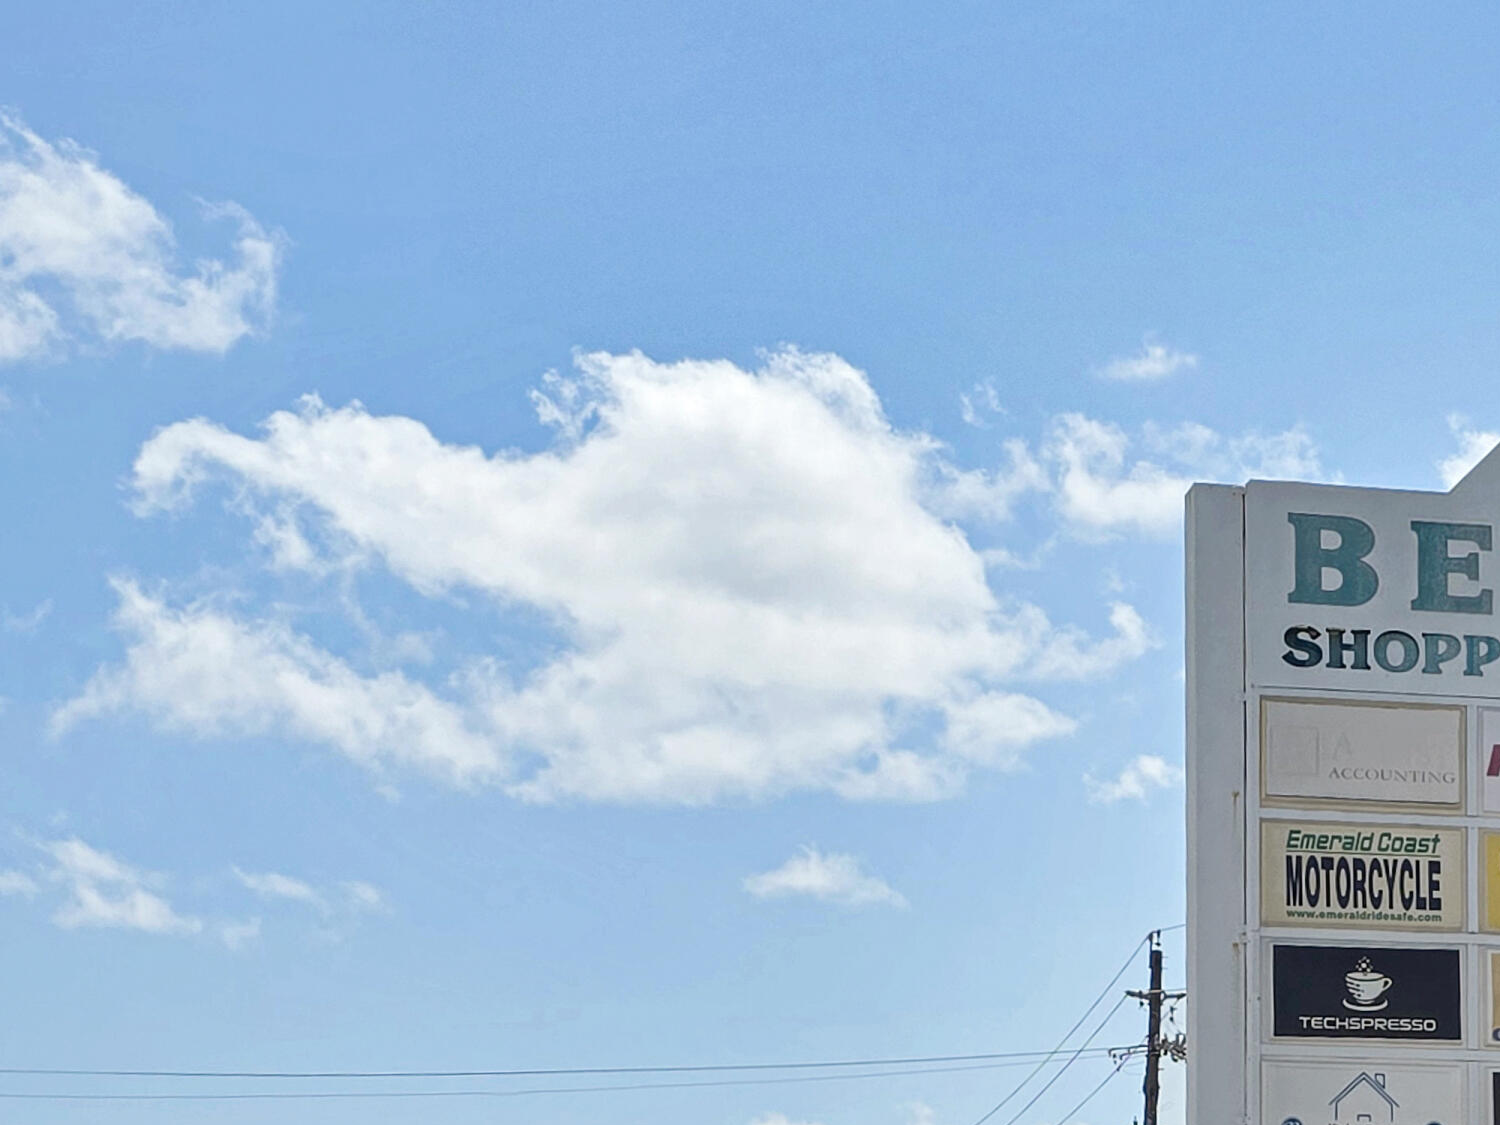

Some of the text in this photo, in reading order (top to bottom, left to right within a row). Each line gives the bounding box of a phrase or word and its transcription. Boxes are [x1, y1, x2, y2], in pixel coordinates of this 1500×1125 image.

[1328, 766, 1457, 785] ACCOUNTING
[1285, 829, 1441, 854] Emerald Coast
[1285, 855, 1442, 911] MOTORCYCLE
[1286, 909, 1442, 922] www.emeraldridesafe.com
[1298, 1016, 1437, 1033] TECHSPRESSO
